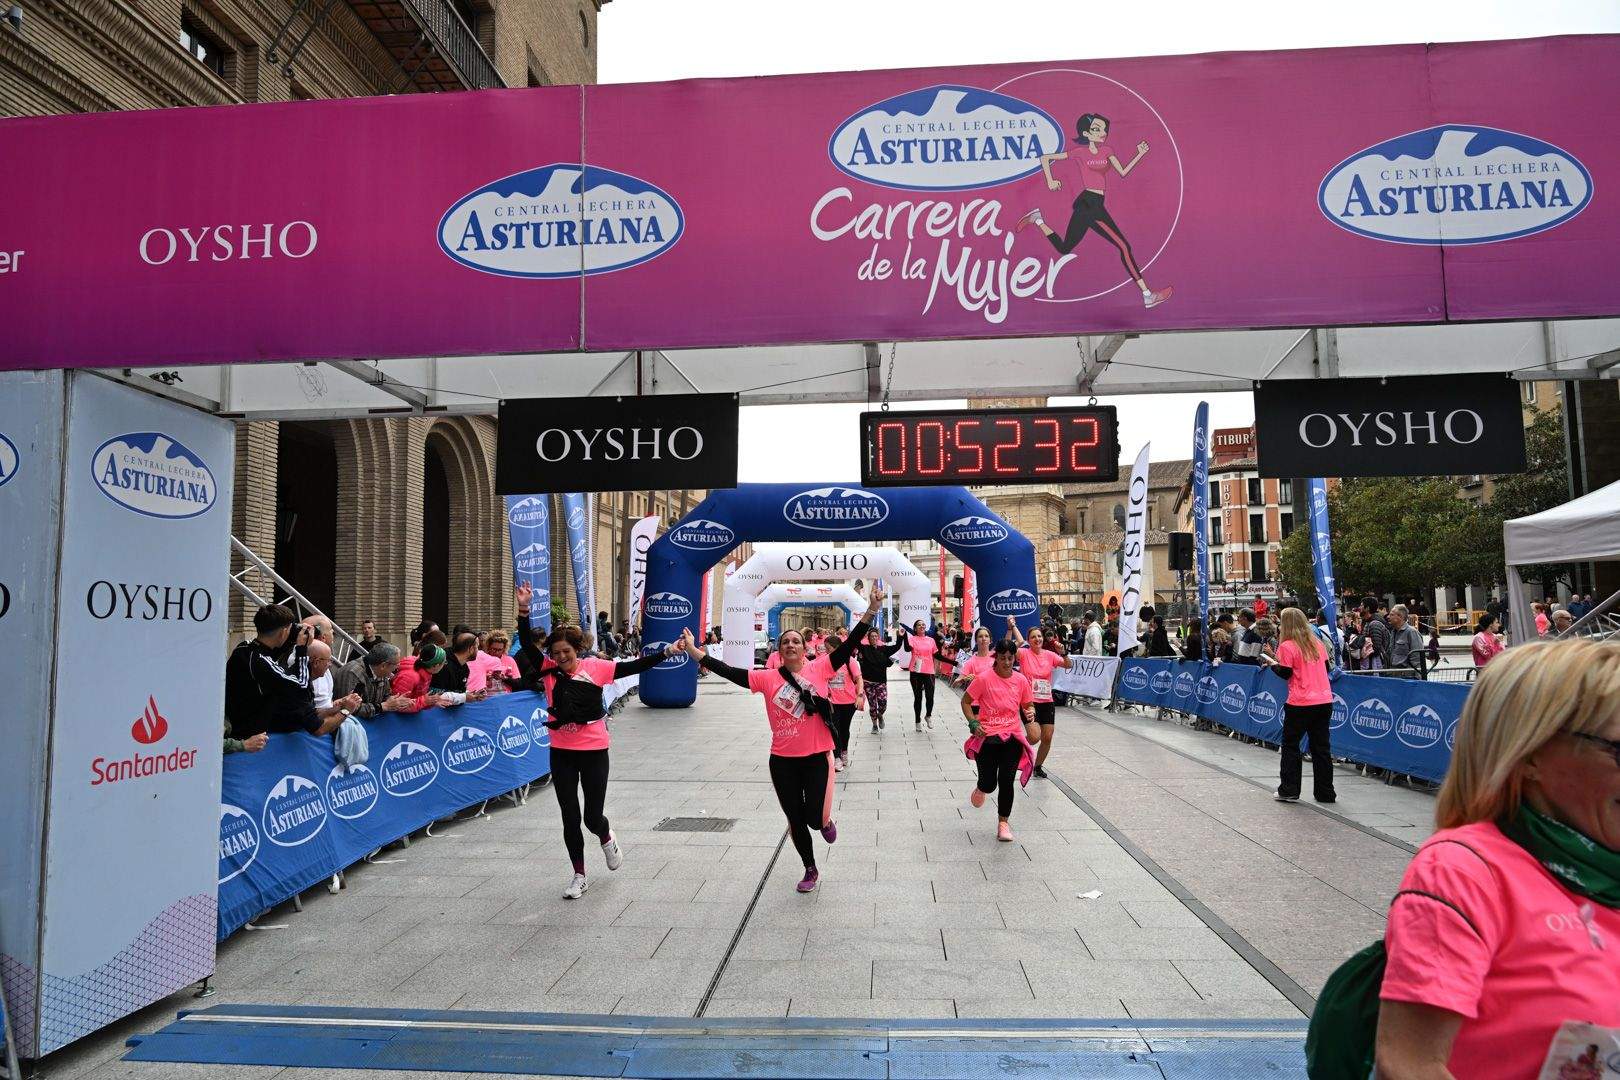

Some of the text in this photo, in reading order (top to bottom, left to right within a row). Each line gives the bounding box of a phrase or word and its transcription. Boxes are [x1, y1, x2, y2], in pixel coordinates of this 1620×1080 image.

[882, 119, 1037, 134] CENTRAL LECHERA
[847, 127, 1044, 166] ASTURIANA
[1380, 162, 1561, 181] CENTRAL LECHERA
[494, 199, 656, 217] CENTRAL LECHERA
[810, 187, 1003, 241] Carrera
[1340, 174, 1573, 217] ASTURIANA
[139, 220, 318, 265] OYSHO
[456, 210, 666, 252] ASTURIANA
[858, 231, 1077, 323] de la Mujer
[536, 426, 704, 462] OYSHO
[1217, 433, 1250, 446] TIBUR
[1299, 409, 1485, 448] OYSHO
[101, 453, 209, 505] ASTURIANA
[124, 454, 207, 480] CENTRAL LECHERA
[792, 501, 881, 520] ASTURIANA
[1223, 485, 1231, 526] HOTEL
[673, 530, 729, 543] ASTURIANA
[946, 529, 1004, 540] ASTURIANA
[1122, 476, 1145, 616] OYSHO
[786, 554, 868, 571] OYSHO
[87, 580, 212, 622] OYSHO
[91, 747, 197, 786] Santander
[447, 743, 492, 767] ASTURIANA
[385, 760, 437, 789] ASTURIANA
[330, 781, 377, 809] ASTURIANA
[269, 799, 326, 838] ASTURIANA
